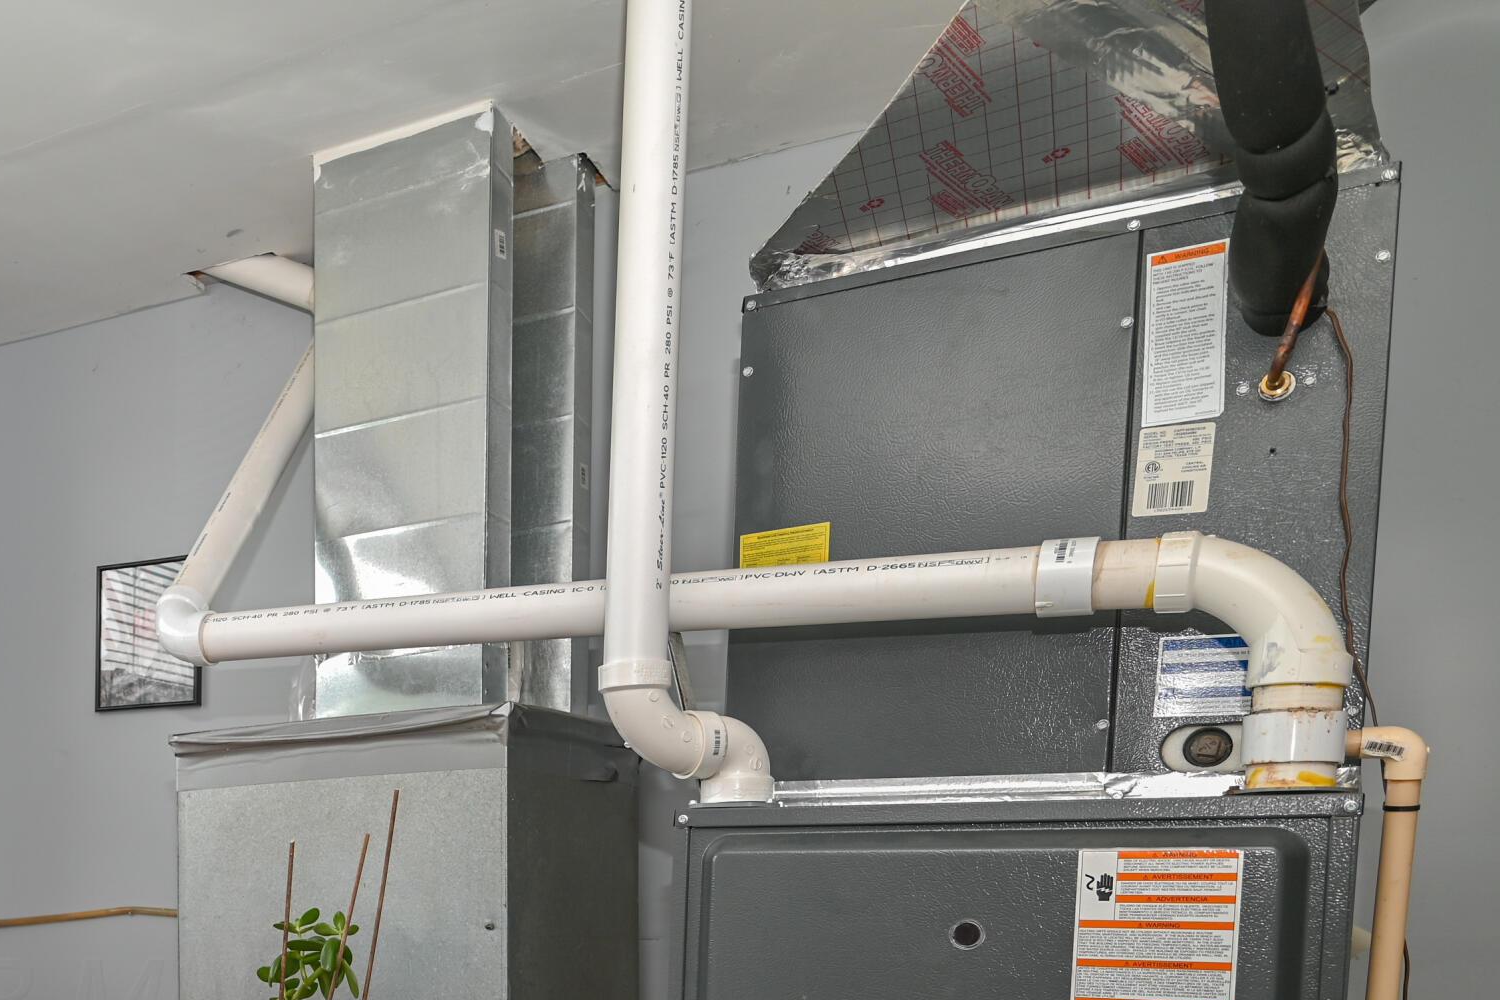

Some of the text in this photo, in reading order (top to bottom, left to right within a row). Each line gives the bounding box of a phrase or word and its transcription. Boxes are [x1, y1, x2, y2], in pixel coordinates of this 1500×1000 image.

[676, 48, 684, 81] WELL
[671, 154, 679, 195] D-1785
[664, 331, 672, 355] 280
[663, 362, 671, 378] PR
[662, 384, 670, 430] SCH-40
[659, 437, 668, 489] PVC-1120
[866, 561, 916, 572] D-2665
[489, 591, 517, 600] WELL
[523, 588, 566, 597] CASING
[1144, 921, 1181, 929] WARNING
[1132, 960, 1193, 969] AVERTISSEMENT
